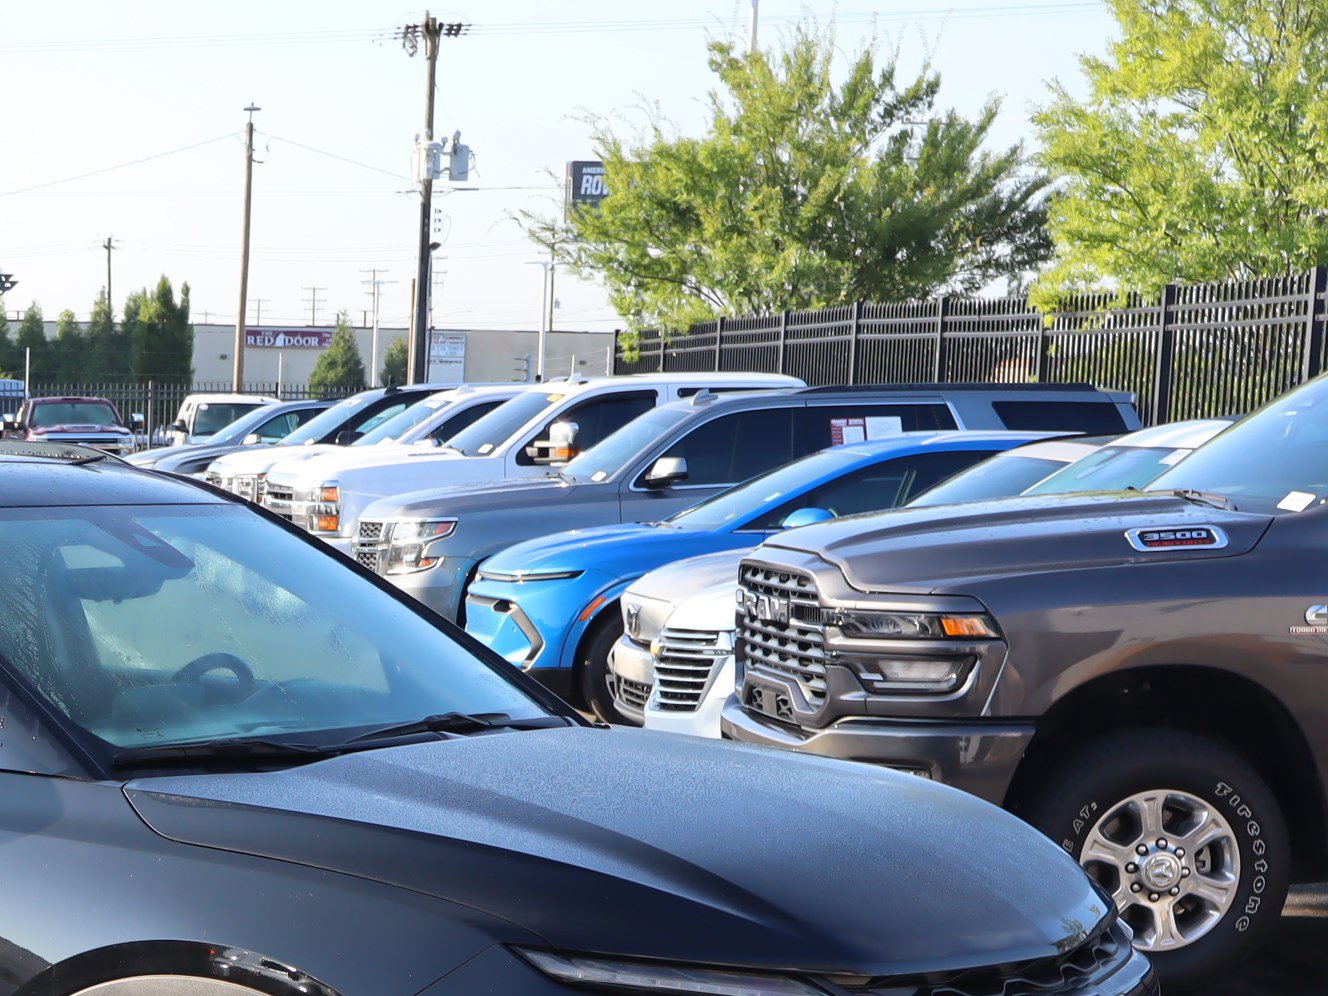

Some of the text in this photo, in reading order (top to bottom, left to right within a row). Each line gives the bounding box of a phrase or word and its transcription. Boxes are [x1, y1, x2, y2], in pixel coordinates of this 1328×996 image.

[247, 336, 274, 346] RED
[285, 336, 319, 347] DOOR
[1144, 531, 1207, 541] 3500
[744, 591, 789, 623] RAM
[1215, 782, 1268, 932] Firestone
